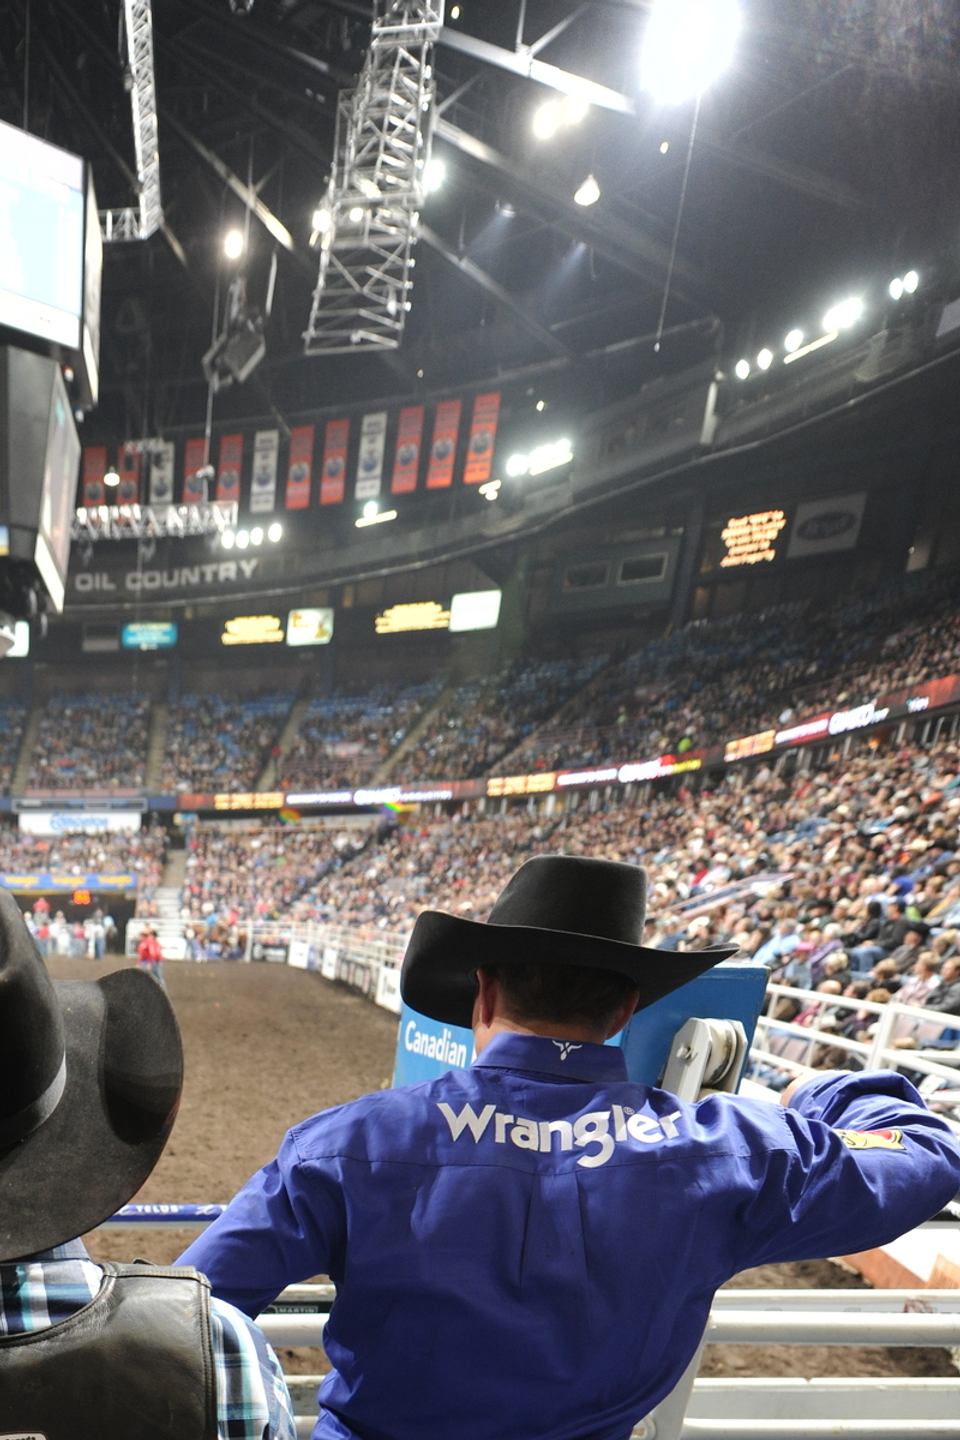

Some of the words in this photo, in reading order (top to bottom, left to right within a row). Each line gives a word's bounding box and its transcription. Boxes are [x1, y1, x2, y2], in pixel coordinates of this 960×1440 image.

[75, 572, 116, 592] OIL
[125, 558, 258, 590] COUNTRY
[405, 1020, 467, 1069] Canadian
[437, 1103, 682, 1168] Wrangler
